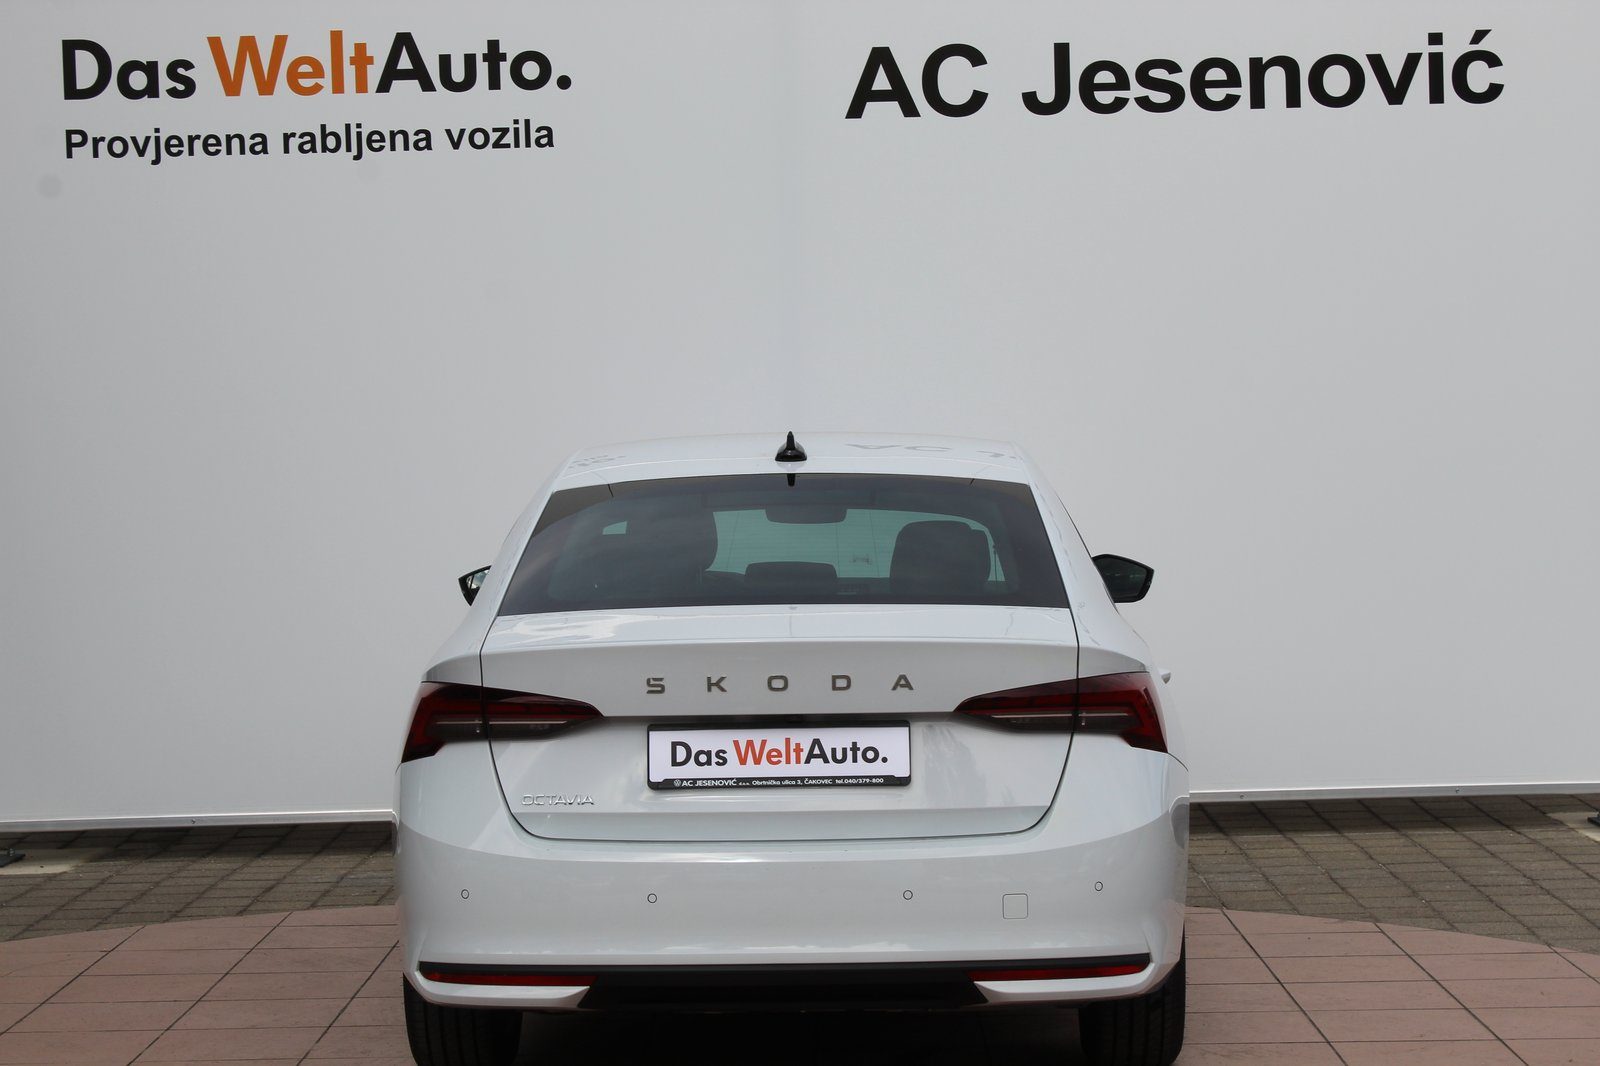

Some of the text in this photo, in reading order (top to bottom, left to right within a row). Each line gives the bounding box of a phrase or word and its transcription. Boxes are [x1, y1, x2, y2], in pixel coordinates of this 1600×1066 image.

[62, 30, 572, 101] Das WeltAuto.
[845, 29, 1505, 120] AC Jesenović
[65, 119, 555, 166] Provjerena rabljena vozila
[646, 674, 914, 695] SKODA
[670, 737, 889, 768] Das WeltAuto.
[695, 778, 737, 787] JESENOVIĆ
[804, 777, 833, 785] ČAKOVEC
[521, 794, 595, 806] OCTAVIA
